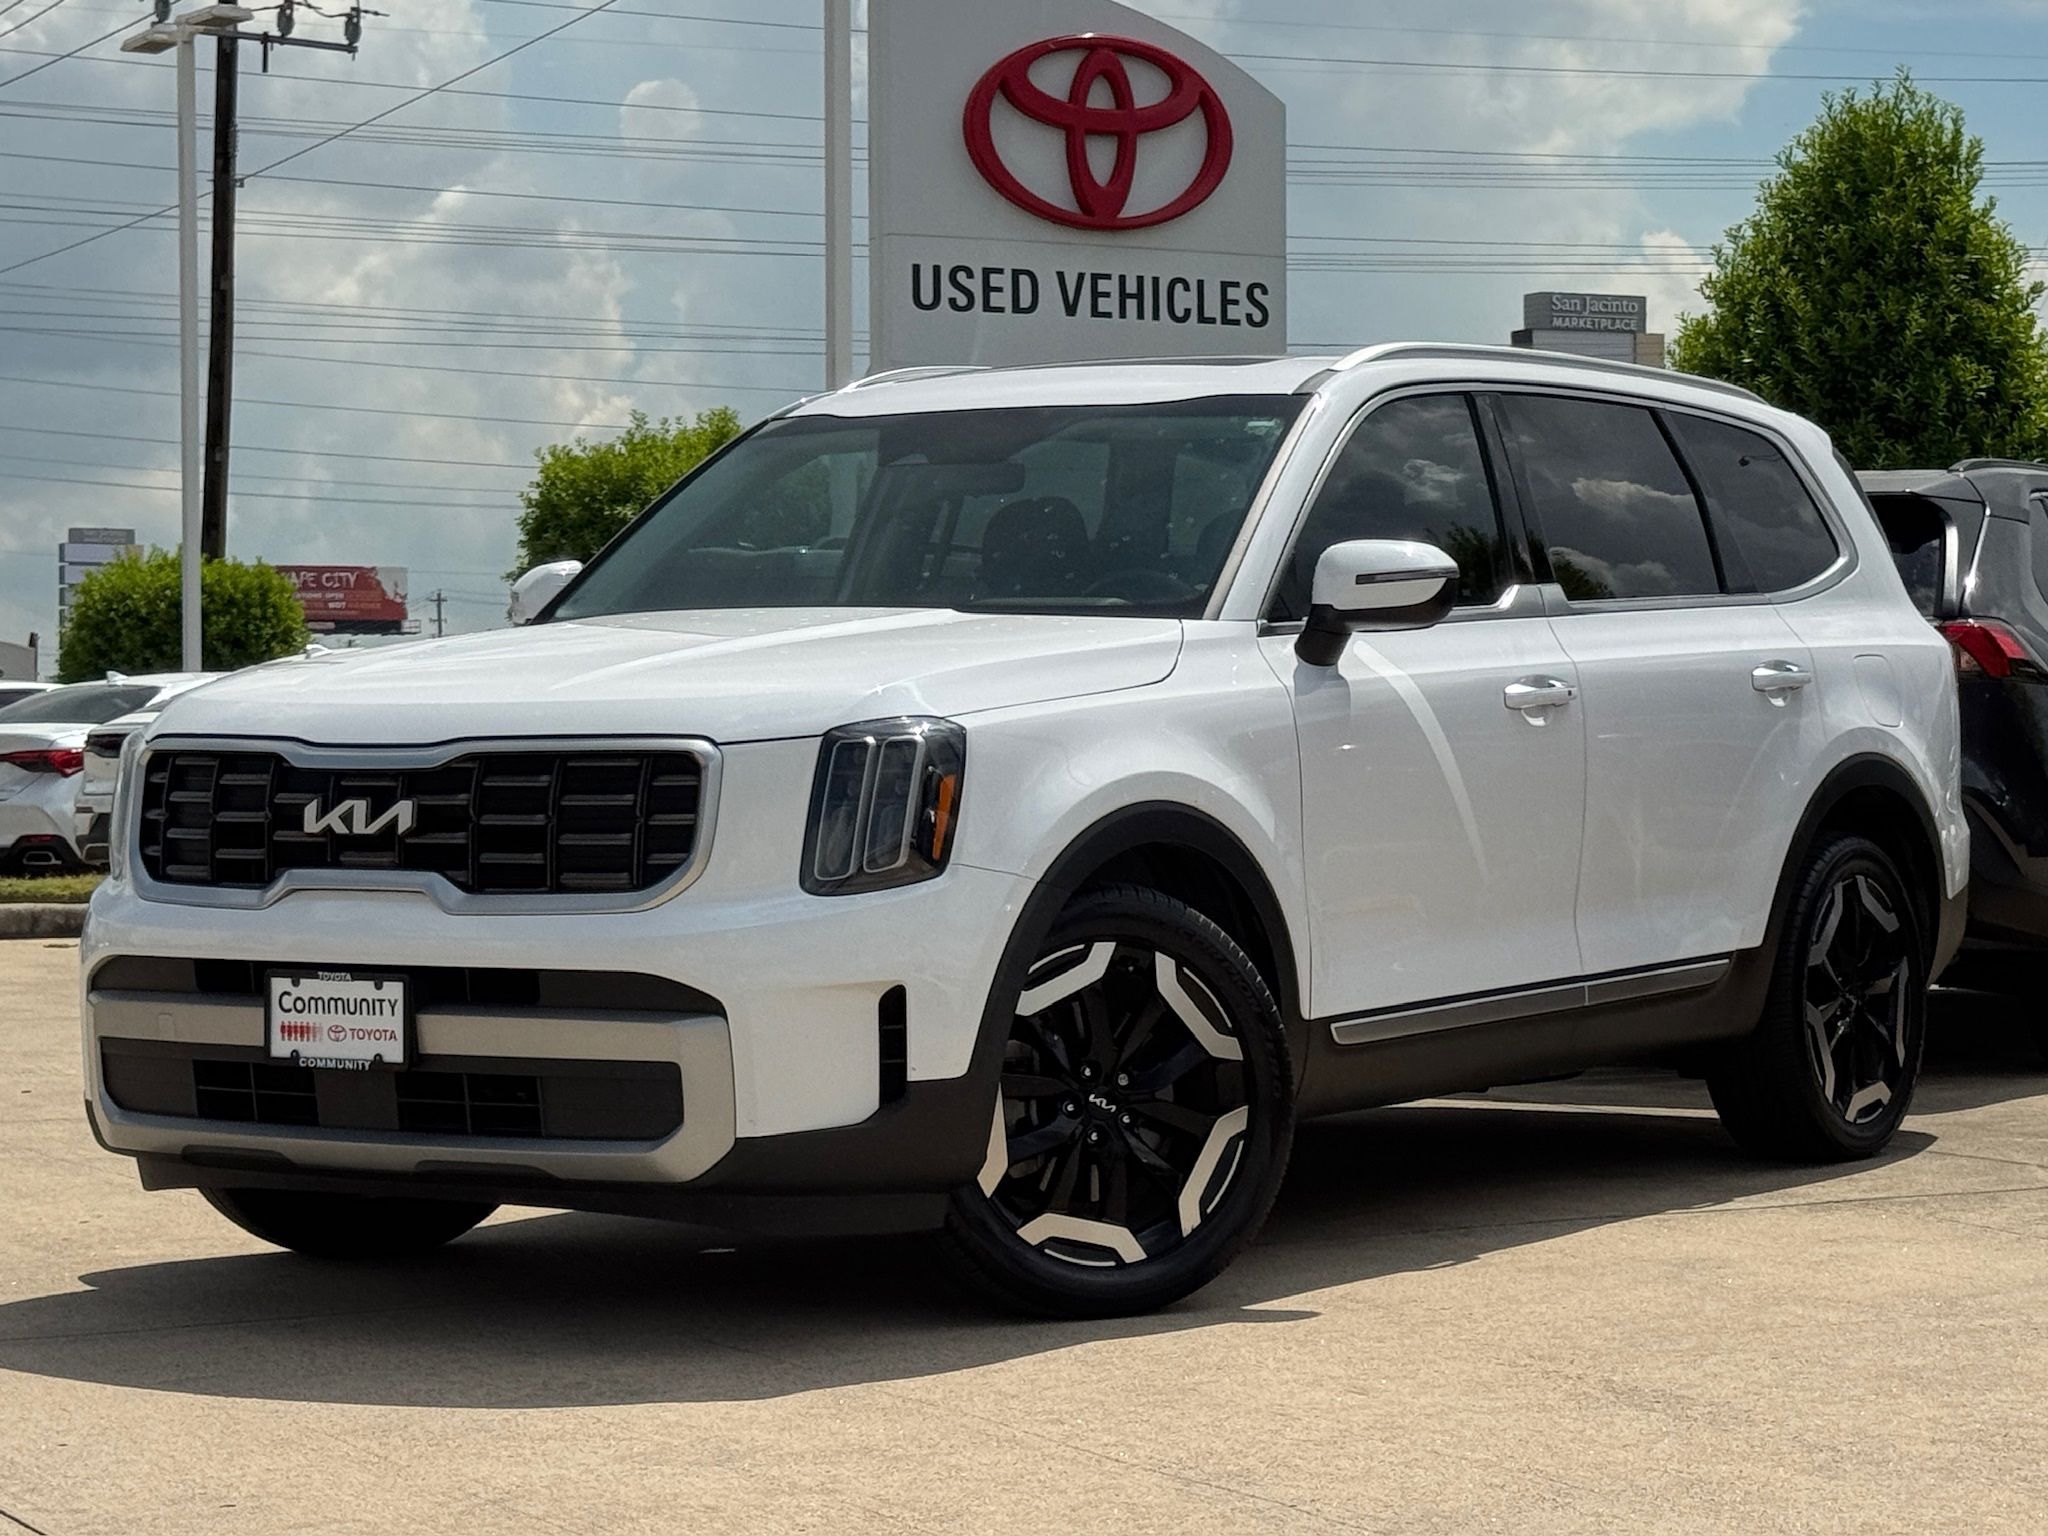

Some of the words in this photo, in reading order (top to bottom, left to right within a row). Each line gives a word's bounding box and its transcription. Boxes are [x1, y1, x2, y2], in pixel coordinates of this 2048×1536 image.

[911, 263, 1040, 315] USED
[1055, 270, 1270, 328] VEHICLES
[1551, 294, 1581, 312] San
[1582, 296, 1638, 316] Jacinto
[1551, 317, 1638, 331] MARKETPLACE
[288, 570, 318, 589] APE
[321, 571, 359, 589] CITY
[303, 798, 413, 835] KIA
[349, 1027, 398, 1042] TOYOTA
[298, 1056, 372, 1071] COMMUNITY
